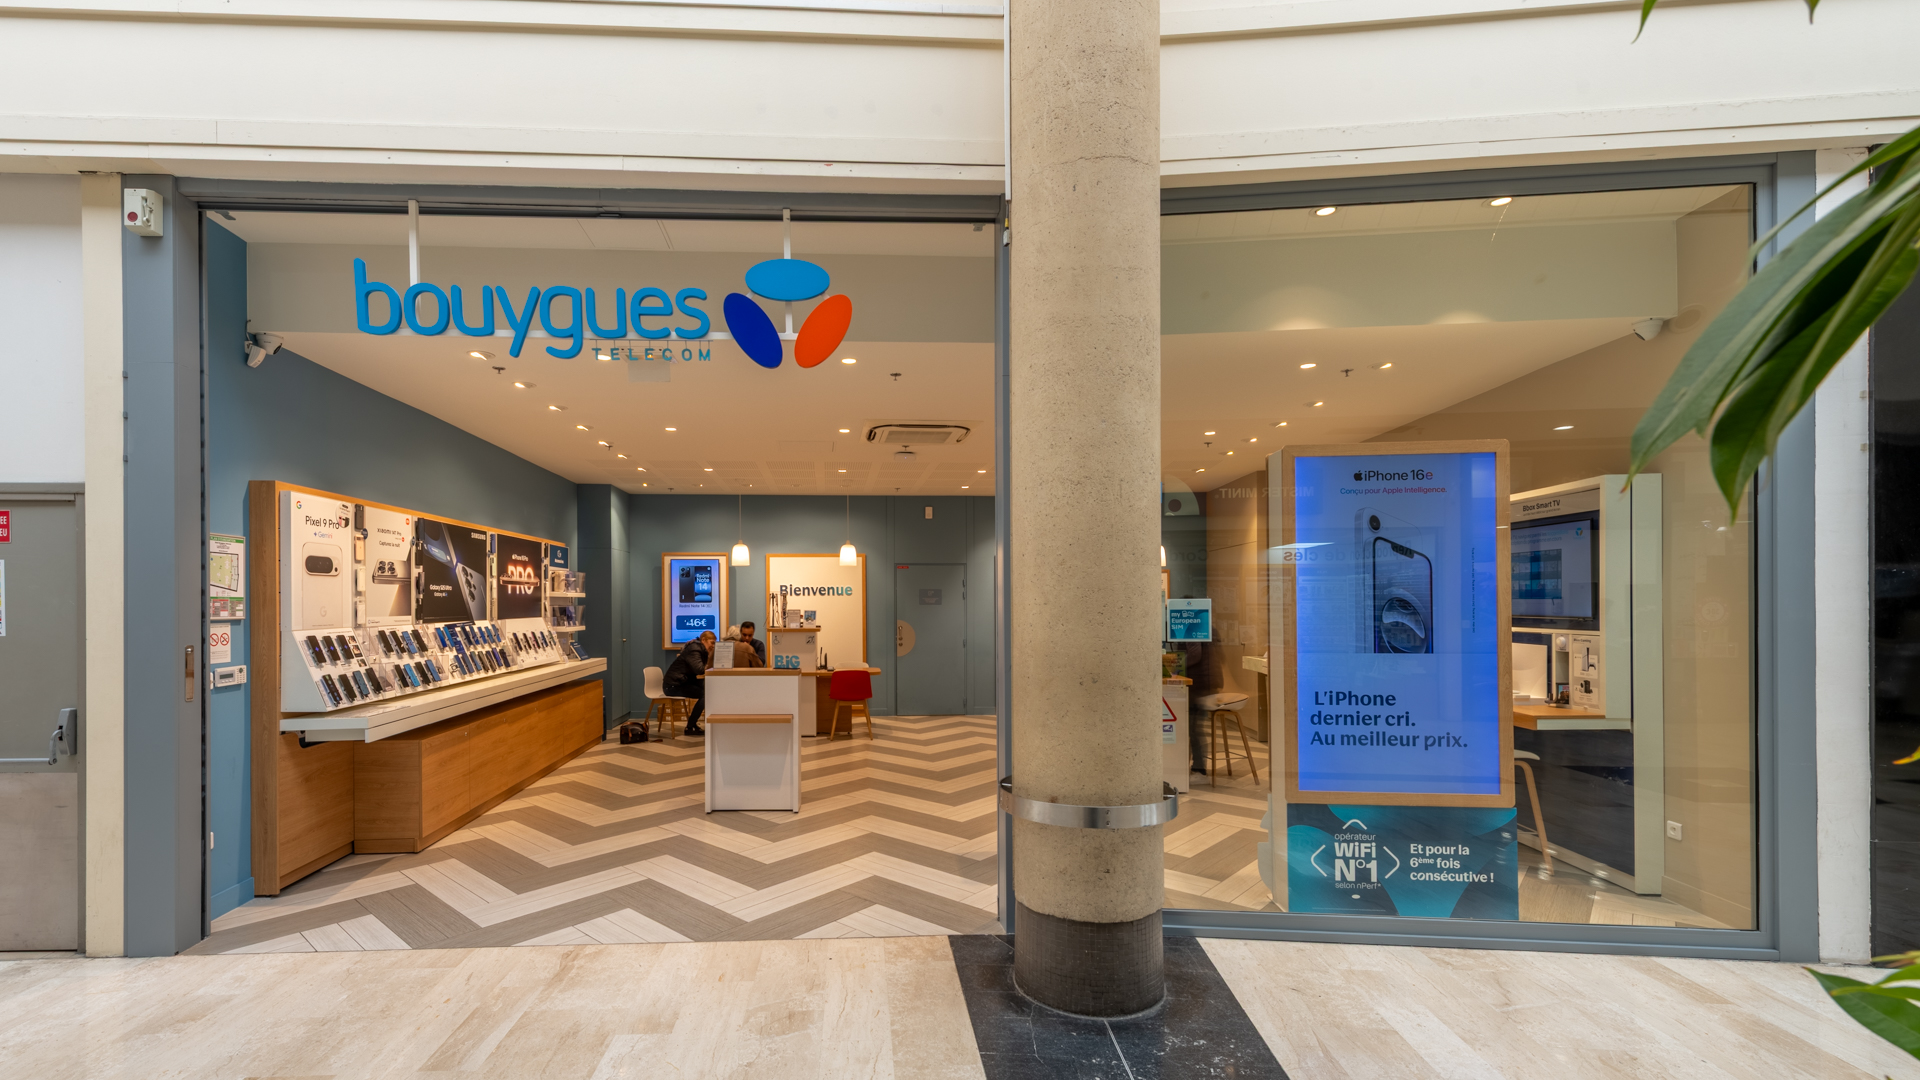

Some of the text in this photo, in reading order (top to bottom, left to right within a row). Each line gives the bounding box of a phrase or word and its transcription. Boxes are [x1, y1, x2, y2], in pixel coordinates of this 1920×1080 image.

[354, 258, 711, 359] bouygues
[591, 347, 712, 362] TELECOM
[1364, 469, 1433, 481] iPhone 16e
[1382, 487, 1403, 495] Apple
[1404, 486, 1447, 495] Intelligence.
[1522, 504, 1535, 512] Bbox
[1536, 501, 1552, 510] Smart
[1552, 499, 1561, 507] TV
[305, 515, 340, 529] Pixel 9 Pro
[318, 531, 333, 539] Gemini
[471, 532, 486, 541] SAMSUNG
[508, 565, 534, 594] PRO
[780, 584, 853, 596] Bienvenue
[1314, 690, 1397, 706] L'iPhone
[1310, 710, 1416, 727] dernier cri.
[1310, 731, 1468, 751] Au meilleur prix.
[1334, 832, 1376, 842] opérateur
[1334, 842, 1377, 858] WiFi
[1410, 844, 1470, 856] Et pour la
[1409, 856, 1461, 869] 6ème fois
[1410, 871, 1488, 882] consécutive
[1335, 881, 1356, 889] selon
